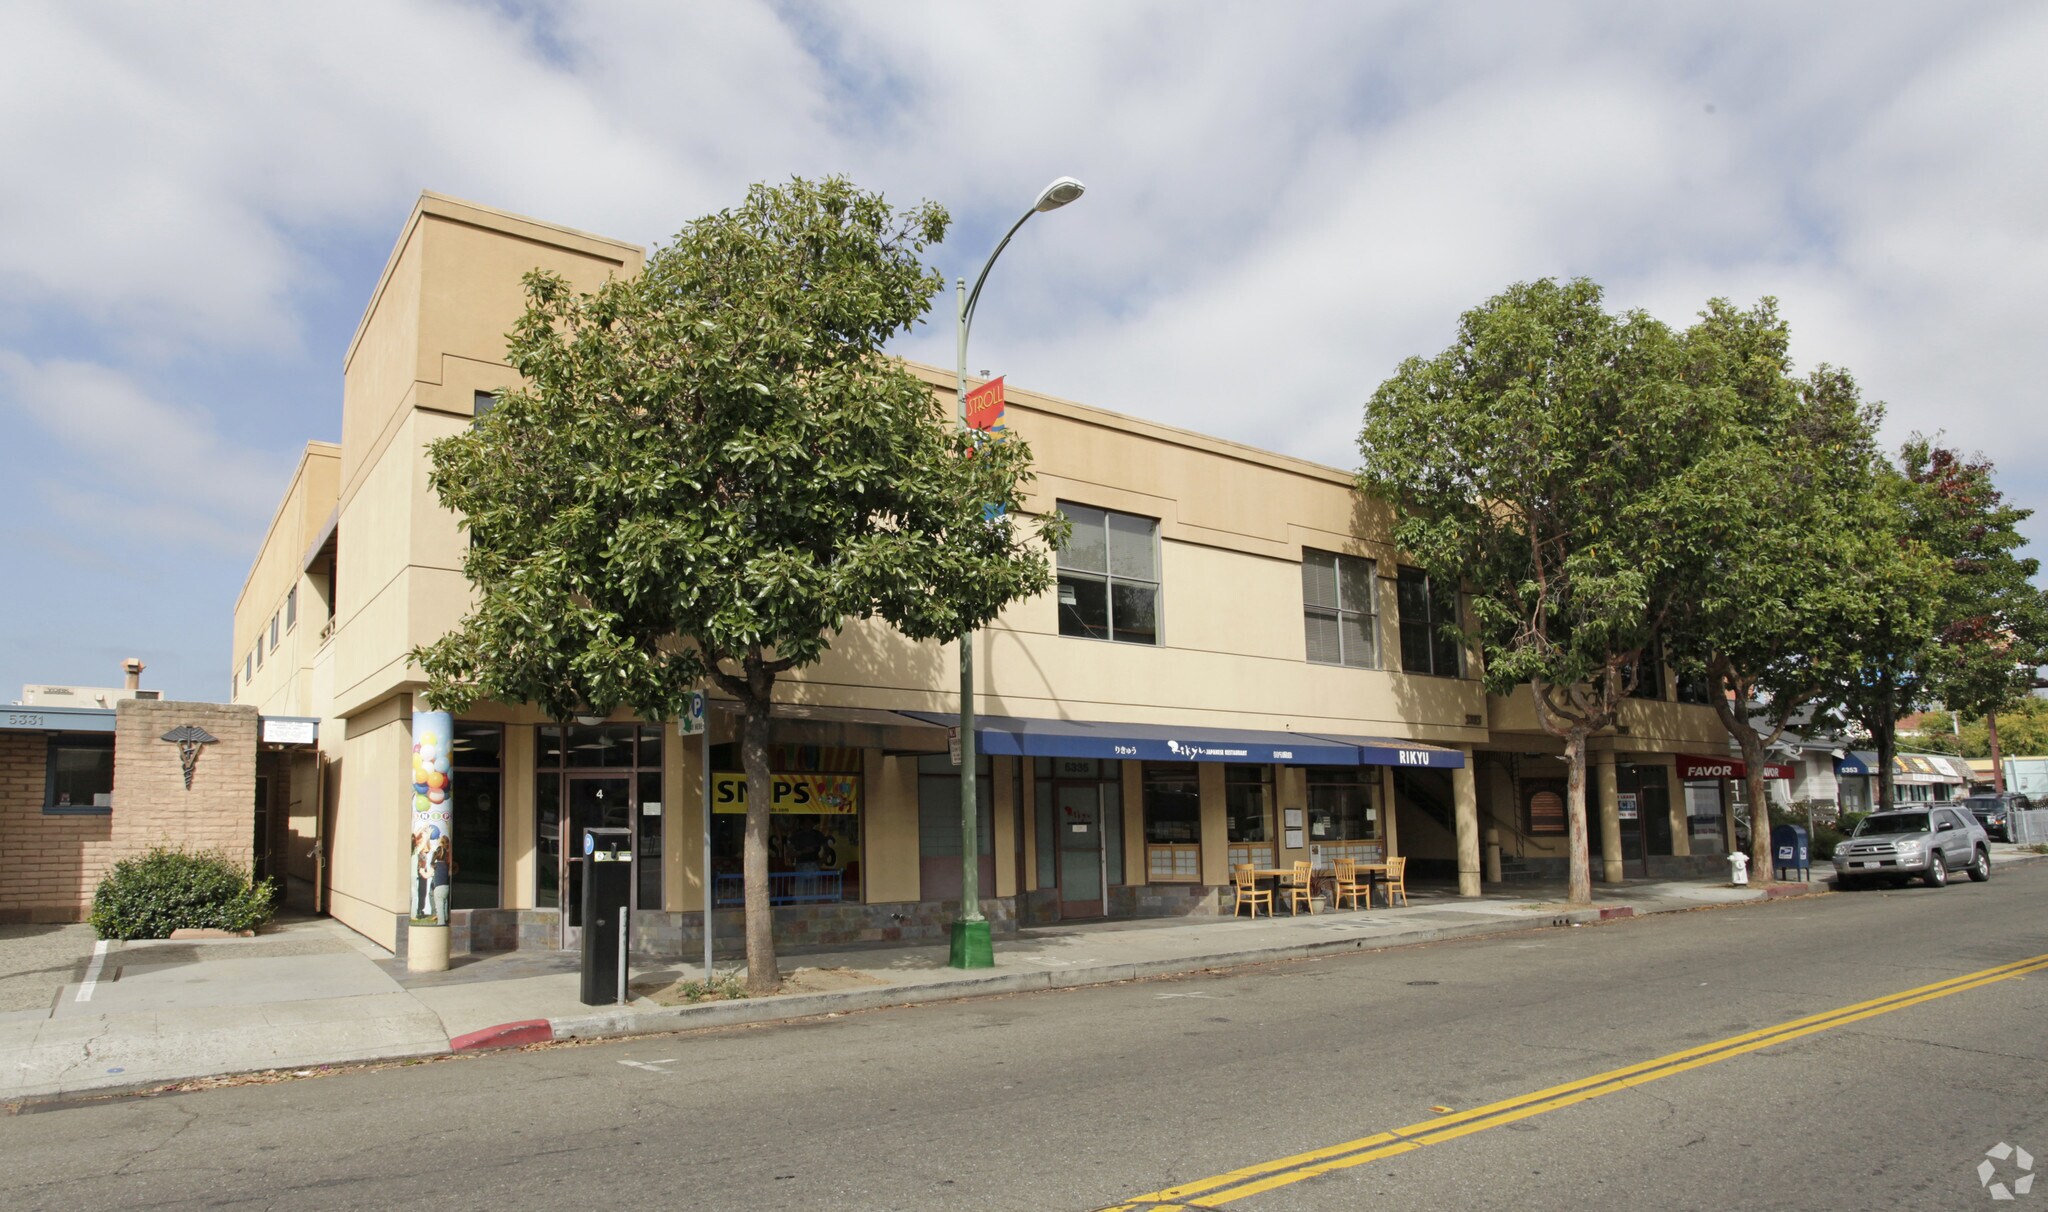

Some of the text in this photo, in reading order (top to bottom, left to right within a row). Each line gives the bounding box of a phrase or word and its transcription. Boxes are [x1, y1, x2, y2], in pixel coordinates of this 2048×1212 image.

[968, 385, 1003, 416] STROLL
[9, 715, 44, 726] 5331
[1399, 750, 1429, 765] RIKYU
[1687, 765, 1732, 777] FAVOR
[1763, 767, 1779, 777] AVOR
[596, 789, 604, 799] 4
[717, 780, 810, 804] SNPS
